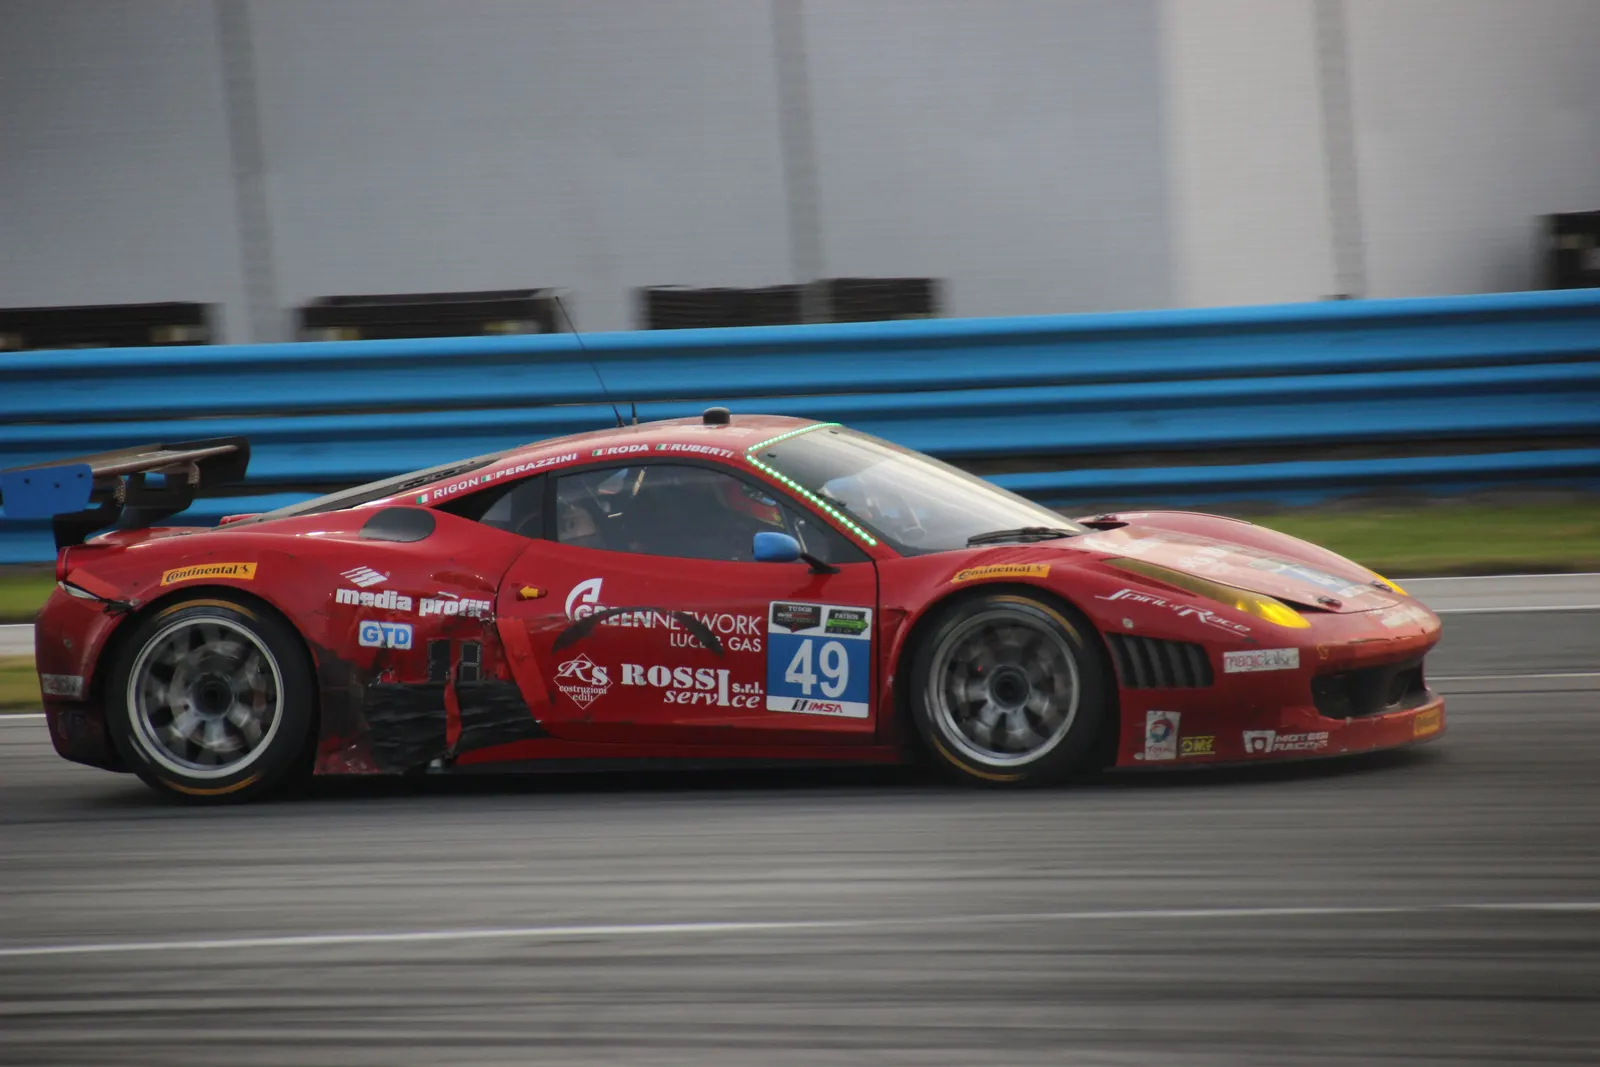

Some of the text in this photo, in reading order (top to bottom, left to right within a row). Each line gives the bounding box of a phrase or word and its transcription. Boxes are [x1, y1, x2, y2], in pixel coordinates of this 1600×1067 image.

[432, 443, 735, 499] RIGON PERAZZINI RODA RUBERTI
[165, 565, 239, 583] Continental
[957, 565, 1032, 580] Continental
[335, 588, 491, 618] media profili
[361, 625, 411, 646] GTD
[728, 636, 763, 653] GAS
[784, 638, 850, 699] 49
[558, 684, 608, 697] costruzioni
[572, 691, 595, 702] edili
